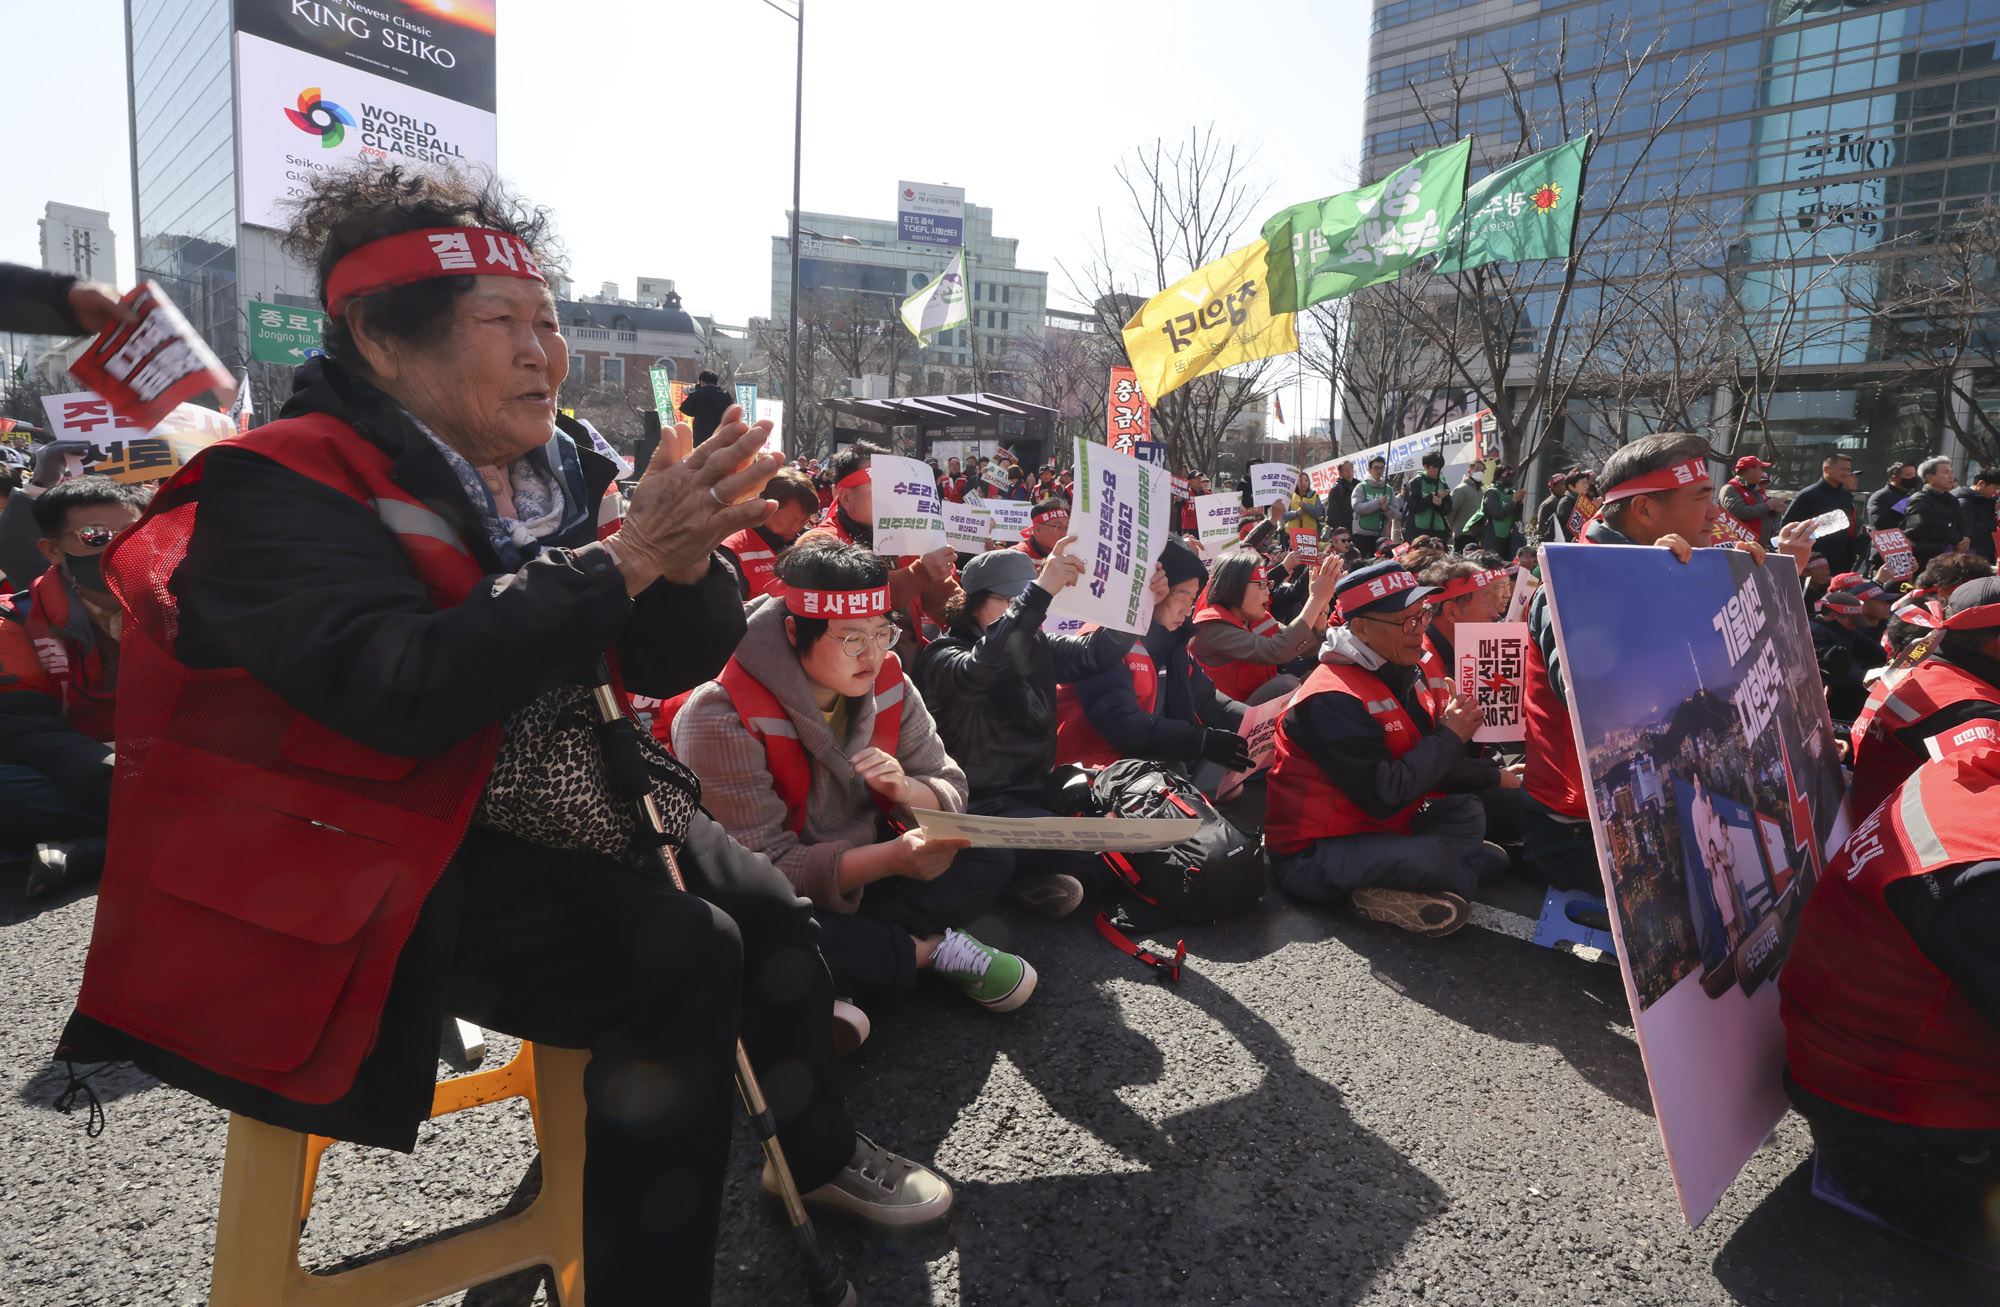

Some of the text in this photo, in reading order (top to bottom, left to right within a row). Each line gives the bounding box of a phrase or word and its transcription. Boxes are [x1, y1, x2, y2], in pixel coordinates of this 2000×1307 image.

[346, 0, 432, 38] Newest Classic
[290, 0, 456, 69] KING SEIKO
[360, 102, 437, 136] WORLD
[361, 117, 465, 158] BASEBALL
[286, 154, 323, 171] Seiko
[361, 146, 387, 158] 2026
[904, 216, 919, 224] ETS
[904, 224, 929, 234] TOEFL
[258, 328, 295, 343] Jongno
[893, 481, 932, 498] 수도권
[878, 517, 928, 530] 민주적인
[1208, 507, 1231, 517] 수도권
[1090, 469, 1117, 599] 수도권 전력수요
[1115, 502, 1133, 575] 분산하고
[1125, 464, 1150, 627] 민주적인 절차 마련하라!
[1874, 531, 1908, 552] 송전선로
[803, 589, 886, 615] 결사반대
[1712, 573, 1766, 668] 기울어진
[1735, 637, 1784, 749] 대한민국
